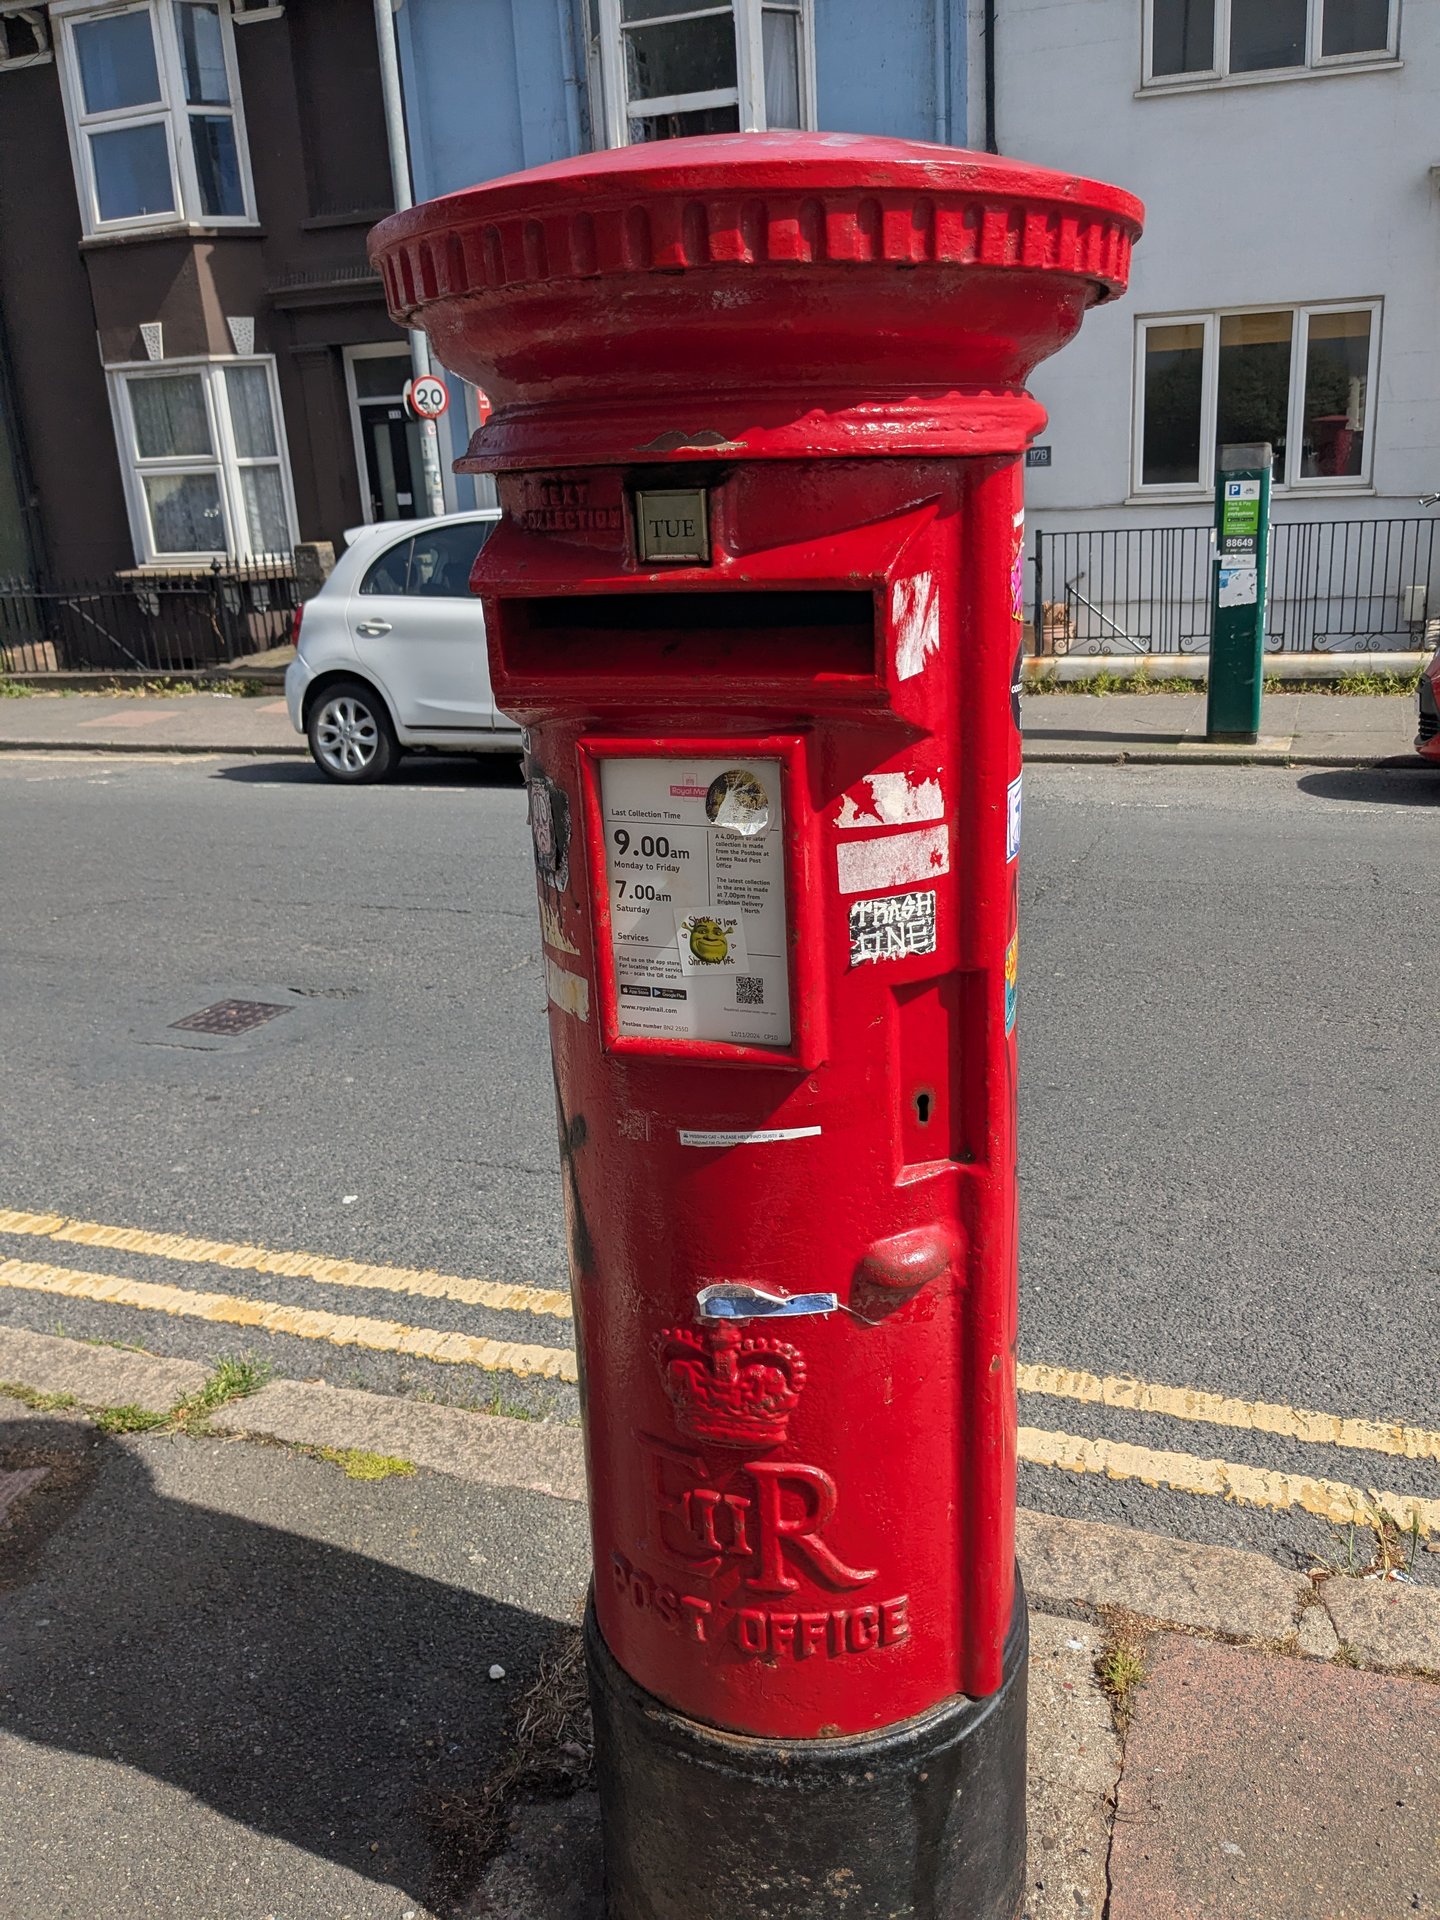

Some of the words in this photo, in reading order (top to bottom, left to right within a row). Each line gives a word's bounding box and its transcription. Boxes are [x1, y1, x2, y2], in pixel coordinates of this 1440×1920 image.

[416, 389, 443, 406] 20
[649, 519, 696, 538] TUE
[1226, 538, 1254, 547] 88649
[672, 786, 692, 796] Royal
[611, 808, 627, 817] Last
[628, 809, 662, 818] Collection
[662, 811, 681, 819] Time
[613, 828, 690, 860] 9.00am
[614, 860, 644, 871] Monday
[656, 863, 681, 873] Friday
[614, 880, 672, 902] 7.00am
[723, 892, 746, 900] 7.00pm
[616, 903, 650, 915] Saturday
[741, 900, 764, 908] Delivery
[852, 892, 932, 928] TRASH
[715, 917, 722, 925] is
[723, 918, 738, 927] love
[617, 932, 649, 942] Services
[661, 991, 677, 999] Google
[620, 1003, 678, 1014] www.royalmail.com
[621, 1020, 642, 1028] Postbox
[642, 1021, 662, 1030] number
[609, 1551, 713, 1643] POST
[736, 1594, 911, 1655] OFFICE
